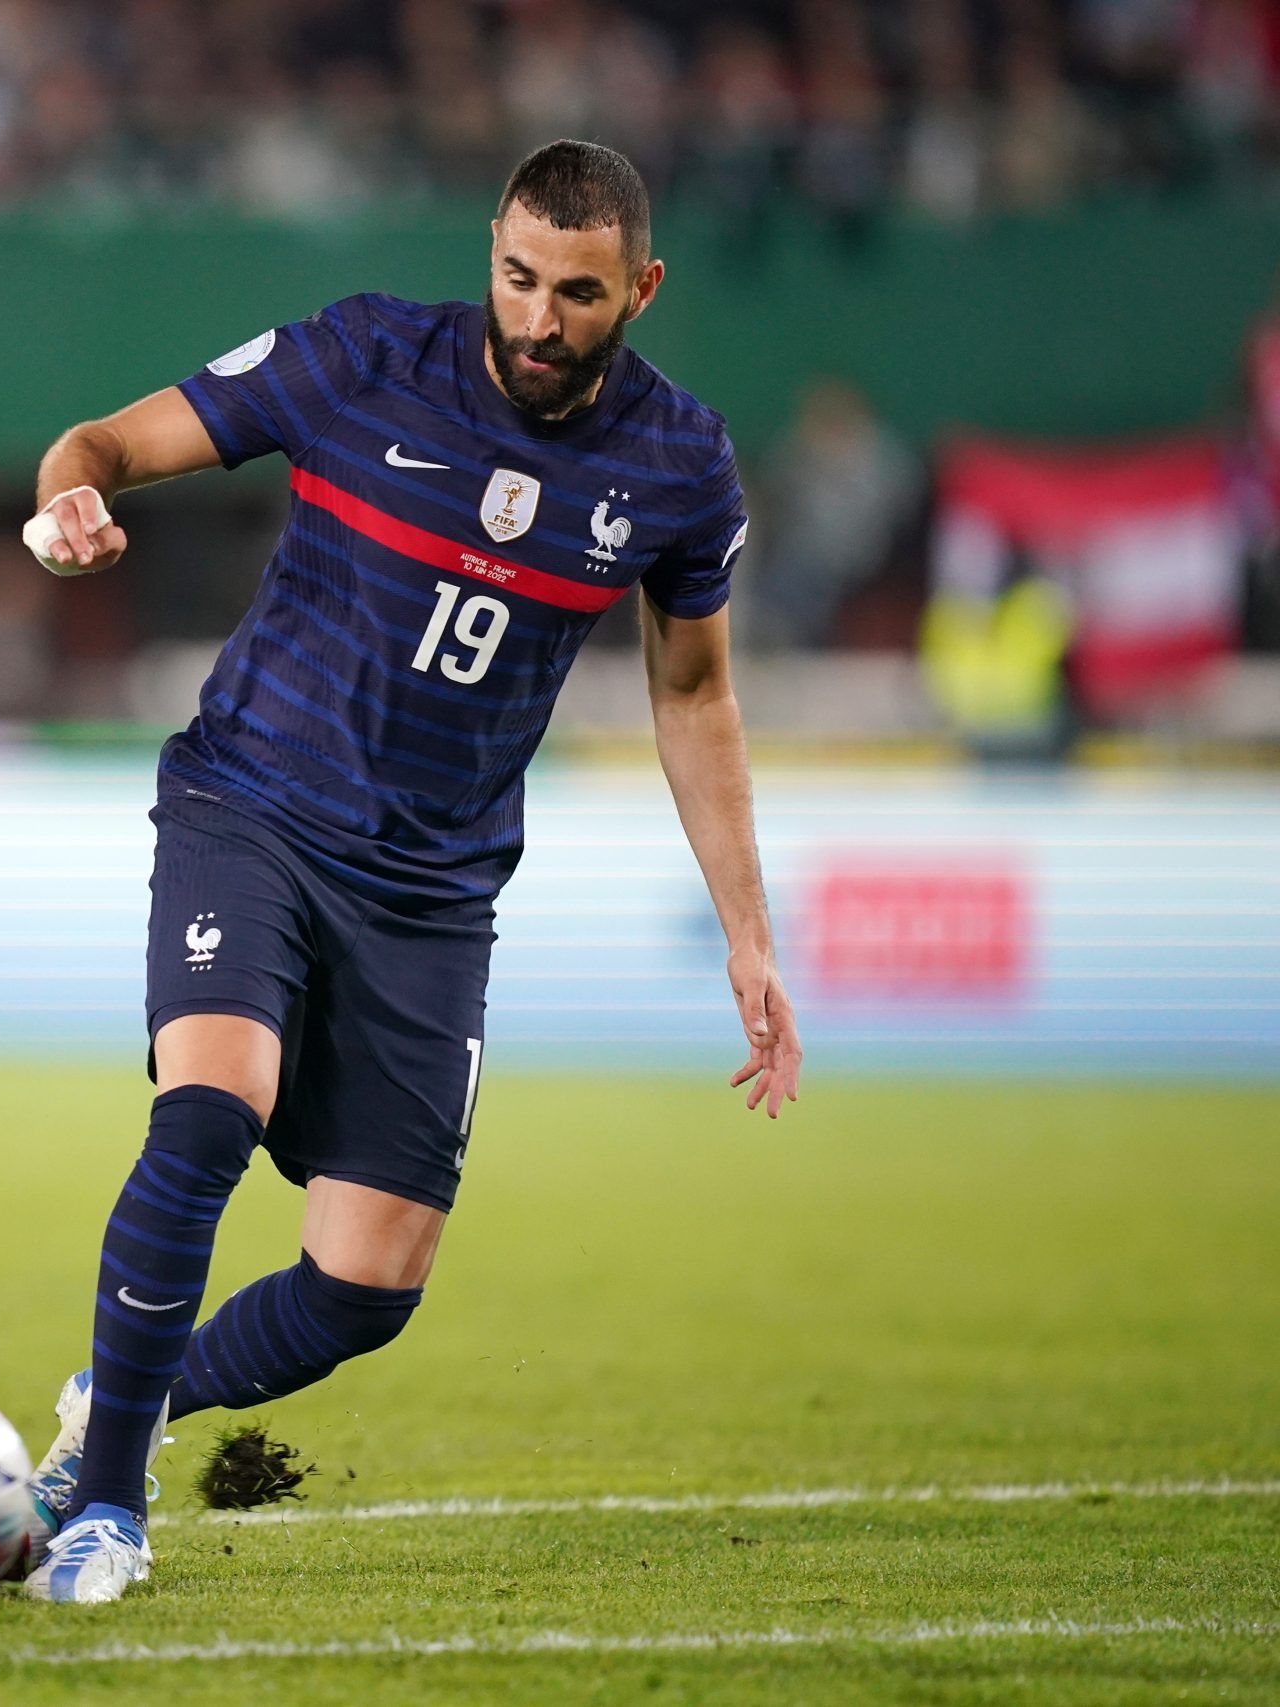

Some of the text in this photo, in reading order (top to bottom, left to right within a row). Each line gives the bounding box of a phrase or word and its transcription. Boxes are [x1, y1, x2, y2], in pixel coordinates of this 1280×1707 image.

[494, 514, 515, 528] FIFA
[460, 553, 489, 568] AUTRICHE
[493, 564, 517, 579] FRANCE
[463, 561, 507, 583] 10 JUIN 2022
[411, 580, 510, 684] 19
